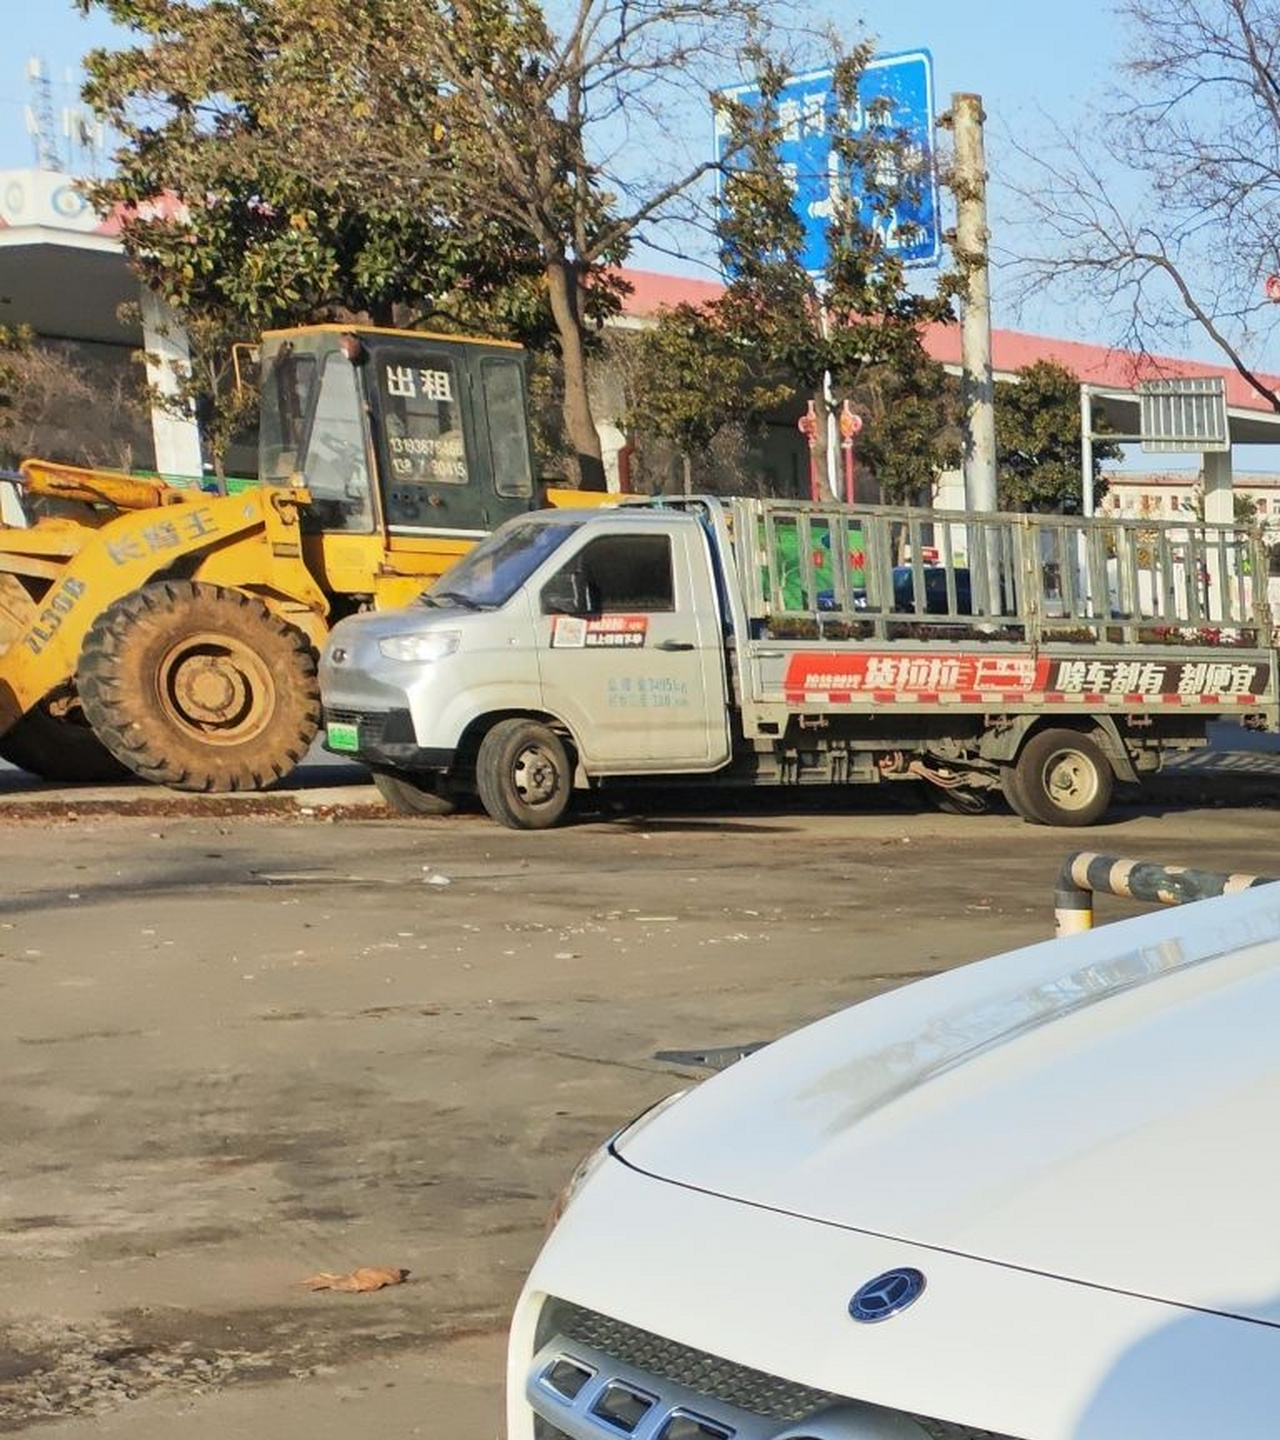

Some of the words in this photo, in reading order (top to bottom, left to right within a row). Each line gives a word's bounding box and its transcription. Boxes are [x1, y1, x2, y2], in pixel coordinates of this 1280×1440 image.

[386, 365, 454, 402] 出租
[862, 656, 961, 692] 货拉拉
[1055, 661, 1167, 695] 啥车都有
[1177, 662, 1257, 695] 都便宜
